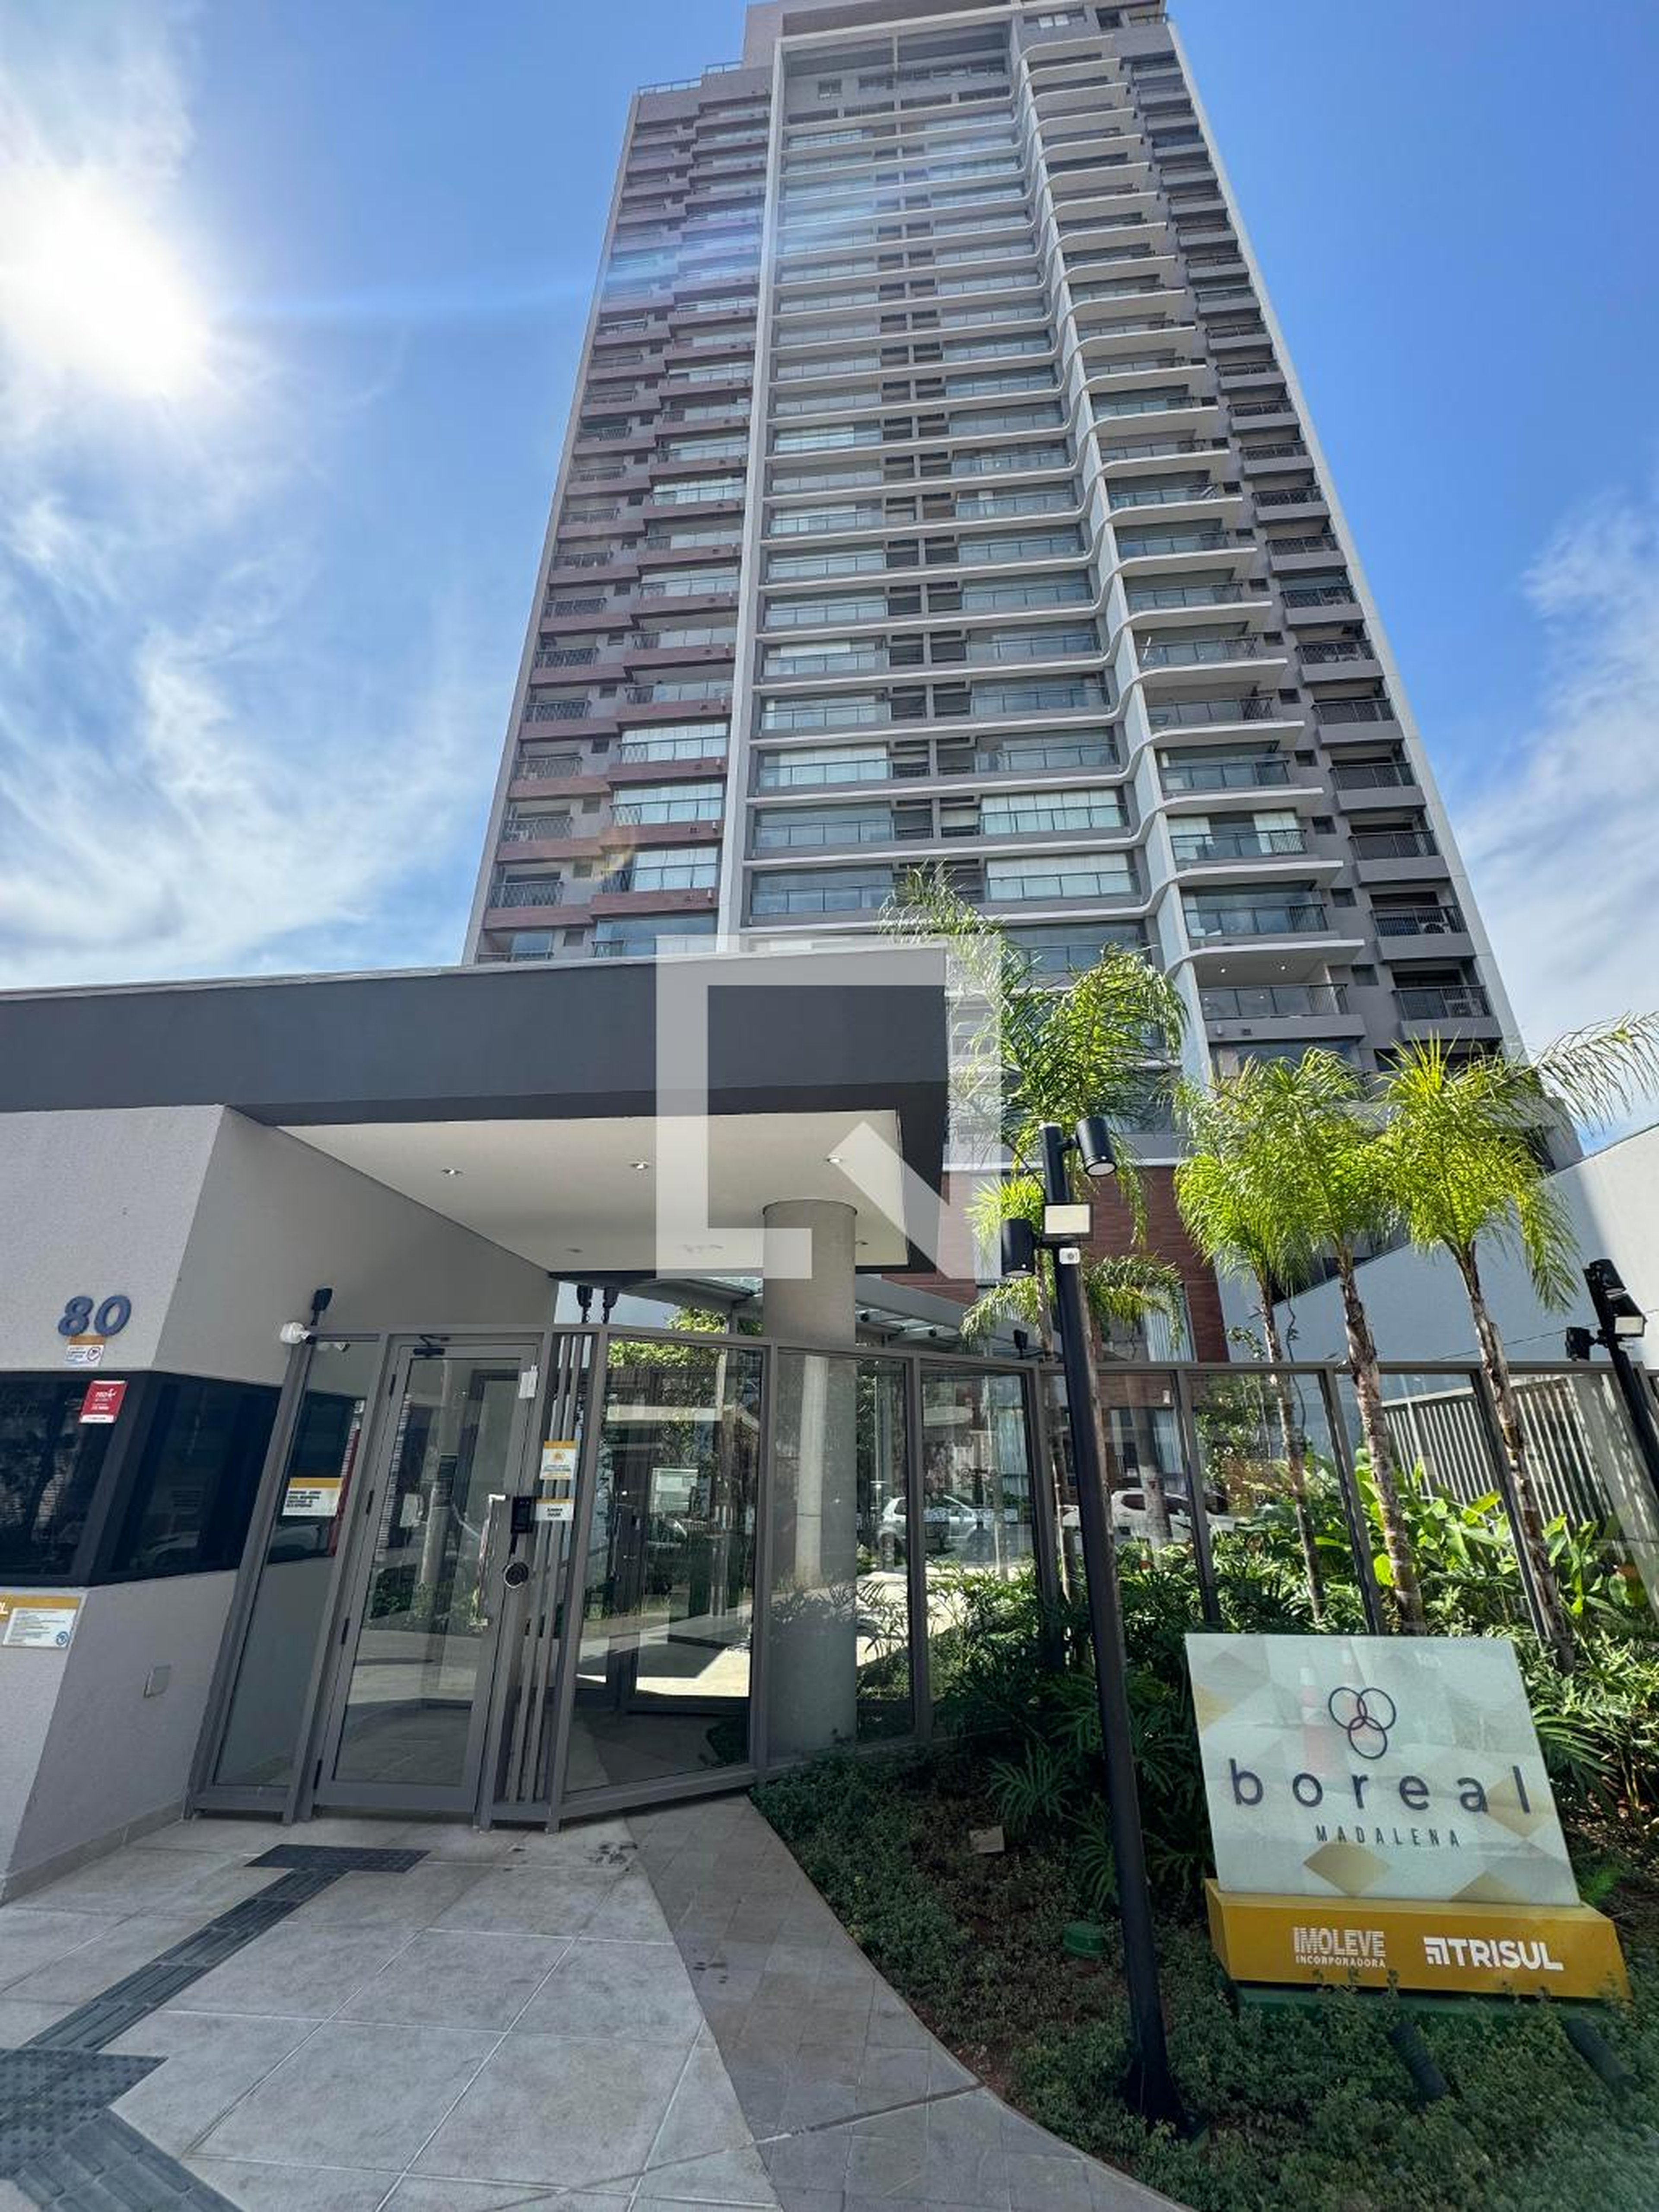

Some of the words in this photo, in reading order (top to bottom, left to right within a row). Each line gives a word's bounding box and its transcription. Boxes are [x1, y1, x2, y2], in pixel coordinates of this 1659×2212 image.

[58, 1295, 131, 1336] 80
[1229, 1758, 1530, 1814] boreal
[1316, 1825, 1461, 1847] MADALENA
[1294, 1927, 1386, 1957] IMOLEVE
[1448, 1938, 1564, 1971] TRISUL
[1296, 1955, 1386, 1968] INCORPORADORA
